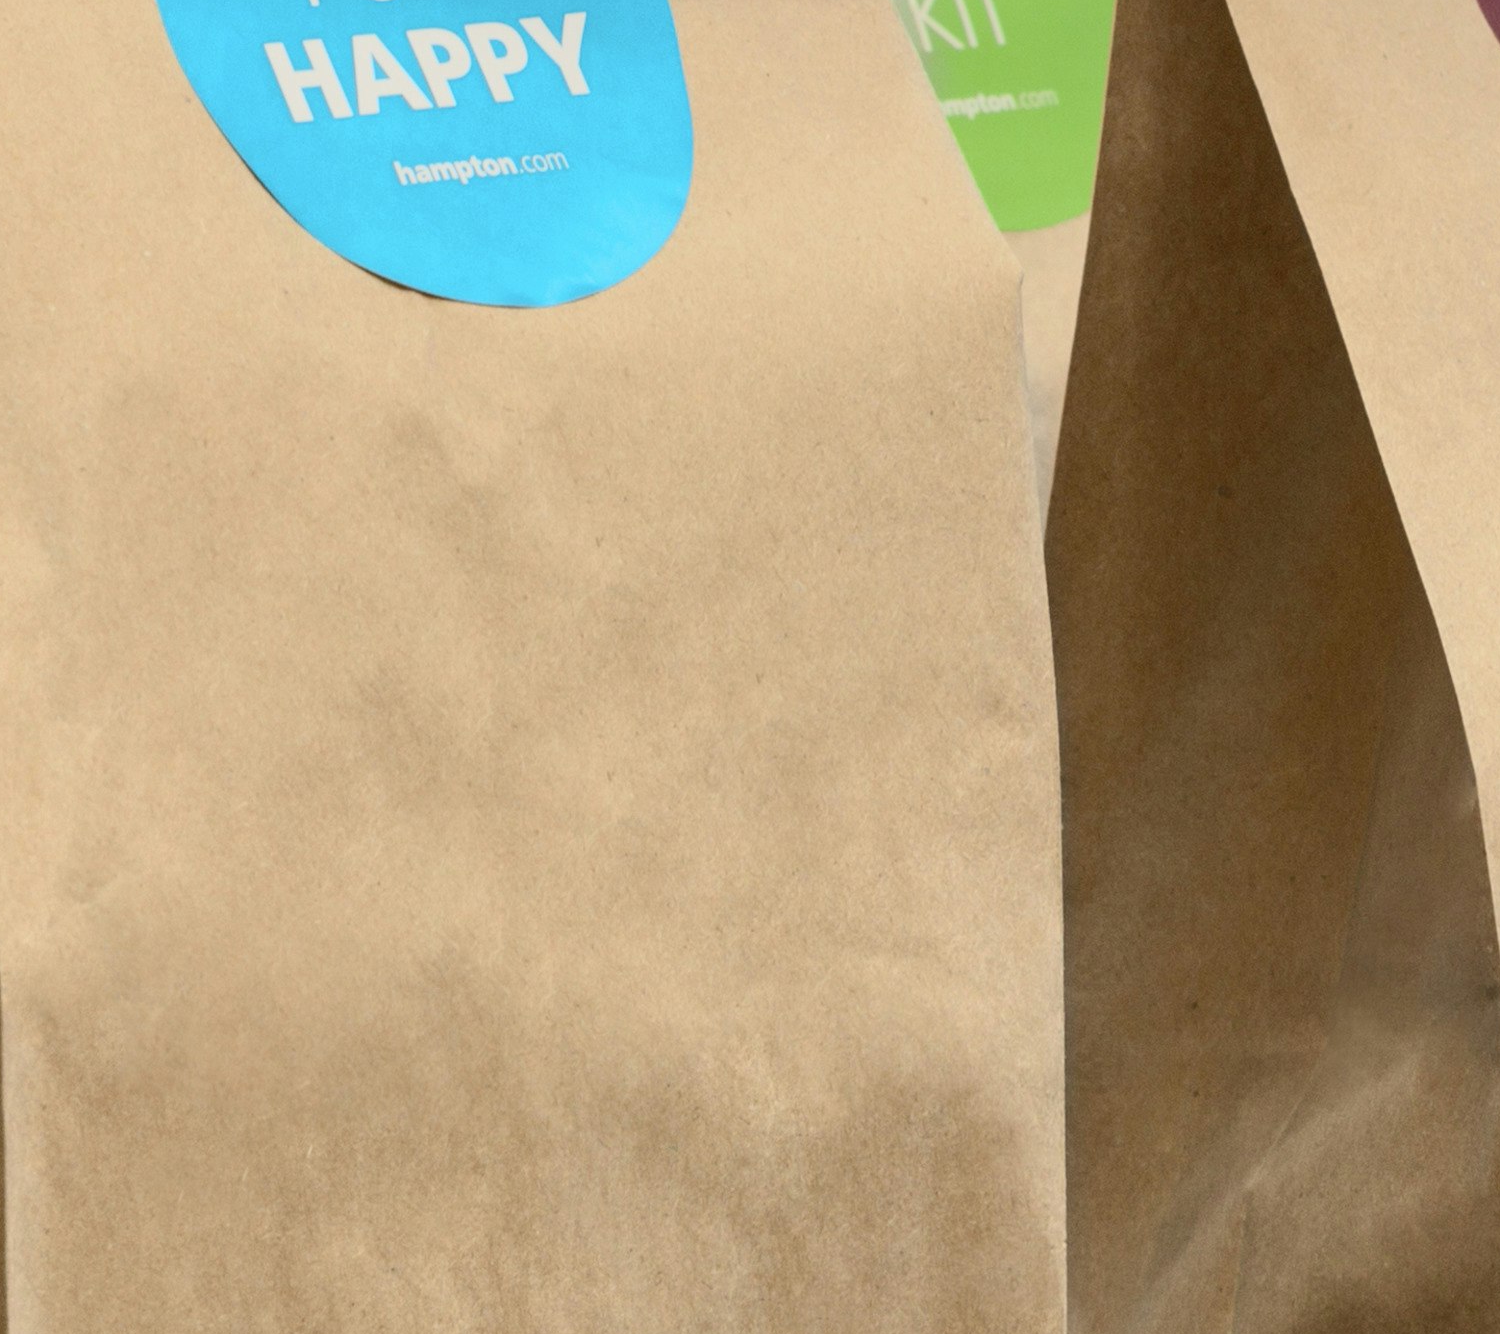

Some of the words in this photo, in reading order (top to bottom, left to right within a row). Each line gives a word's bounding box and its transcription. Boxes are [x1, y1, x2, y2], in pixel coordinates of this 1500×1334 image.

[264, 11, 591, 123] HAPPY
[942, 90, 1060, 121] mpton.com
[393, 149, 569, 186] hampton.com
